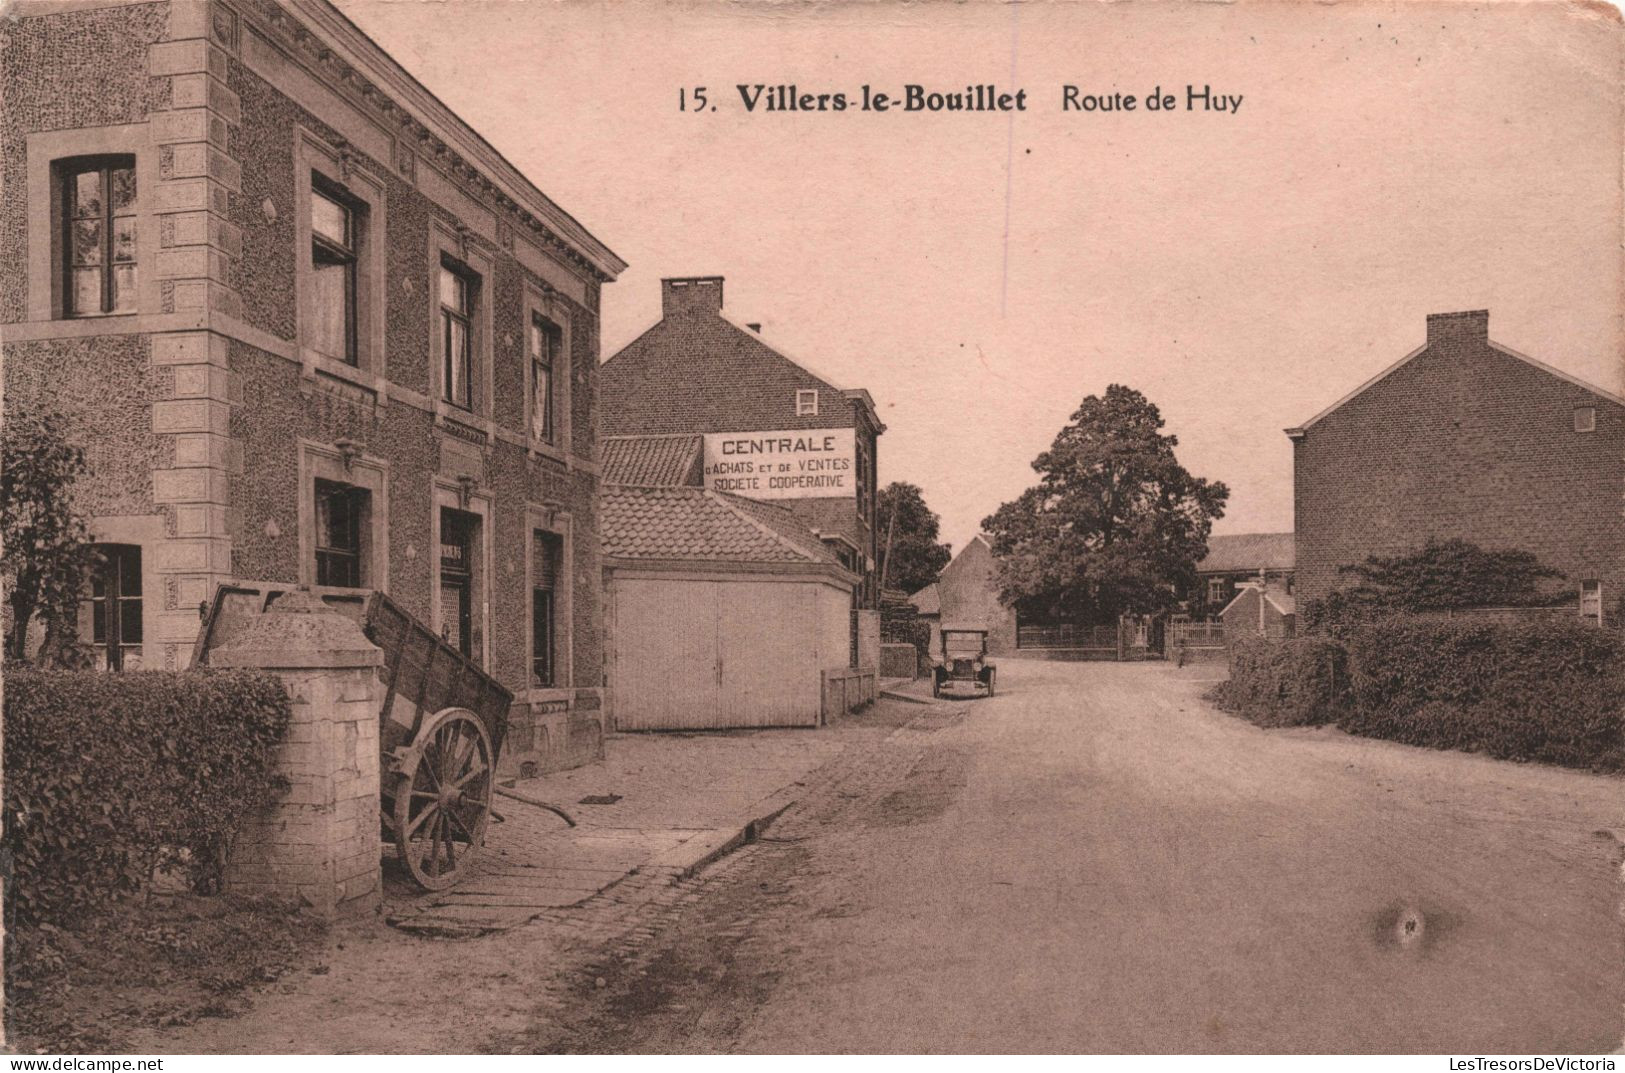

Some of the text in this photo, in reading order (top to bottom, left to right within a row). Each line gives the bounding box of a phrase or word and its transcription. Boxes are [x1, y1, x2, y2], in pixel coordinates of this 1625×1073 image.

[722, 437, 835, 455] CENTRALE
[759, 463, 773, 473] ET
[778, 463, 792, 473] DE
[798, 458, 850, 471] VENTES
